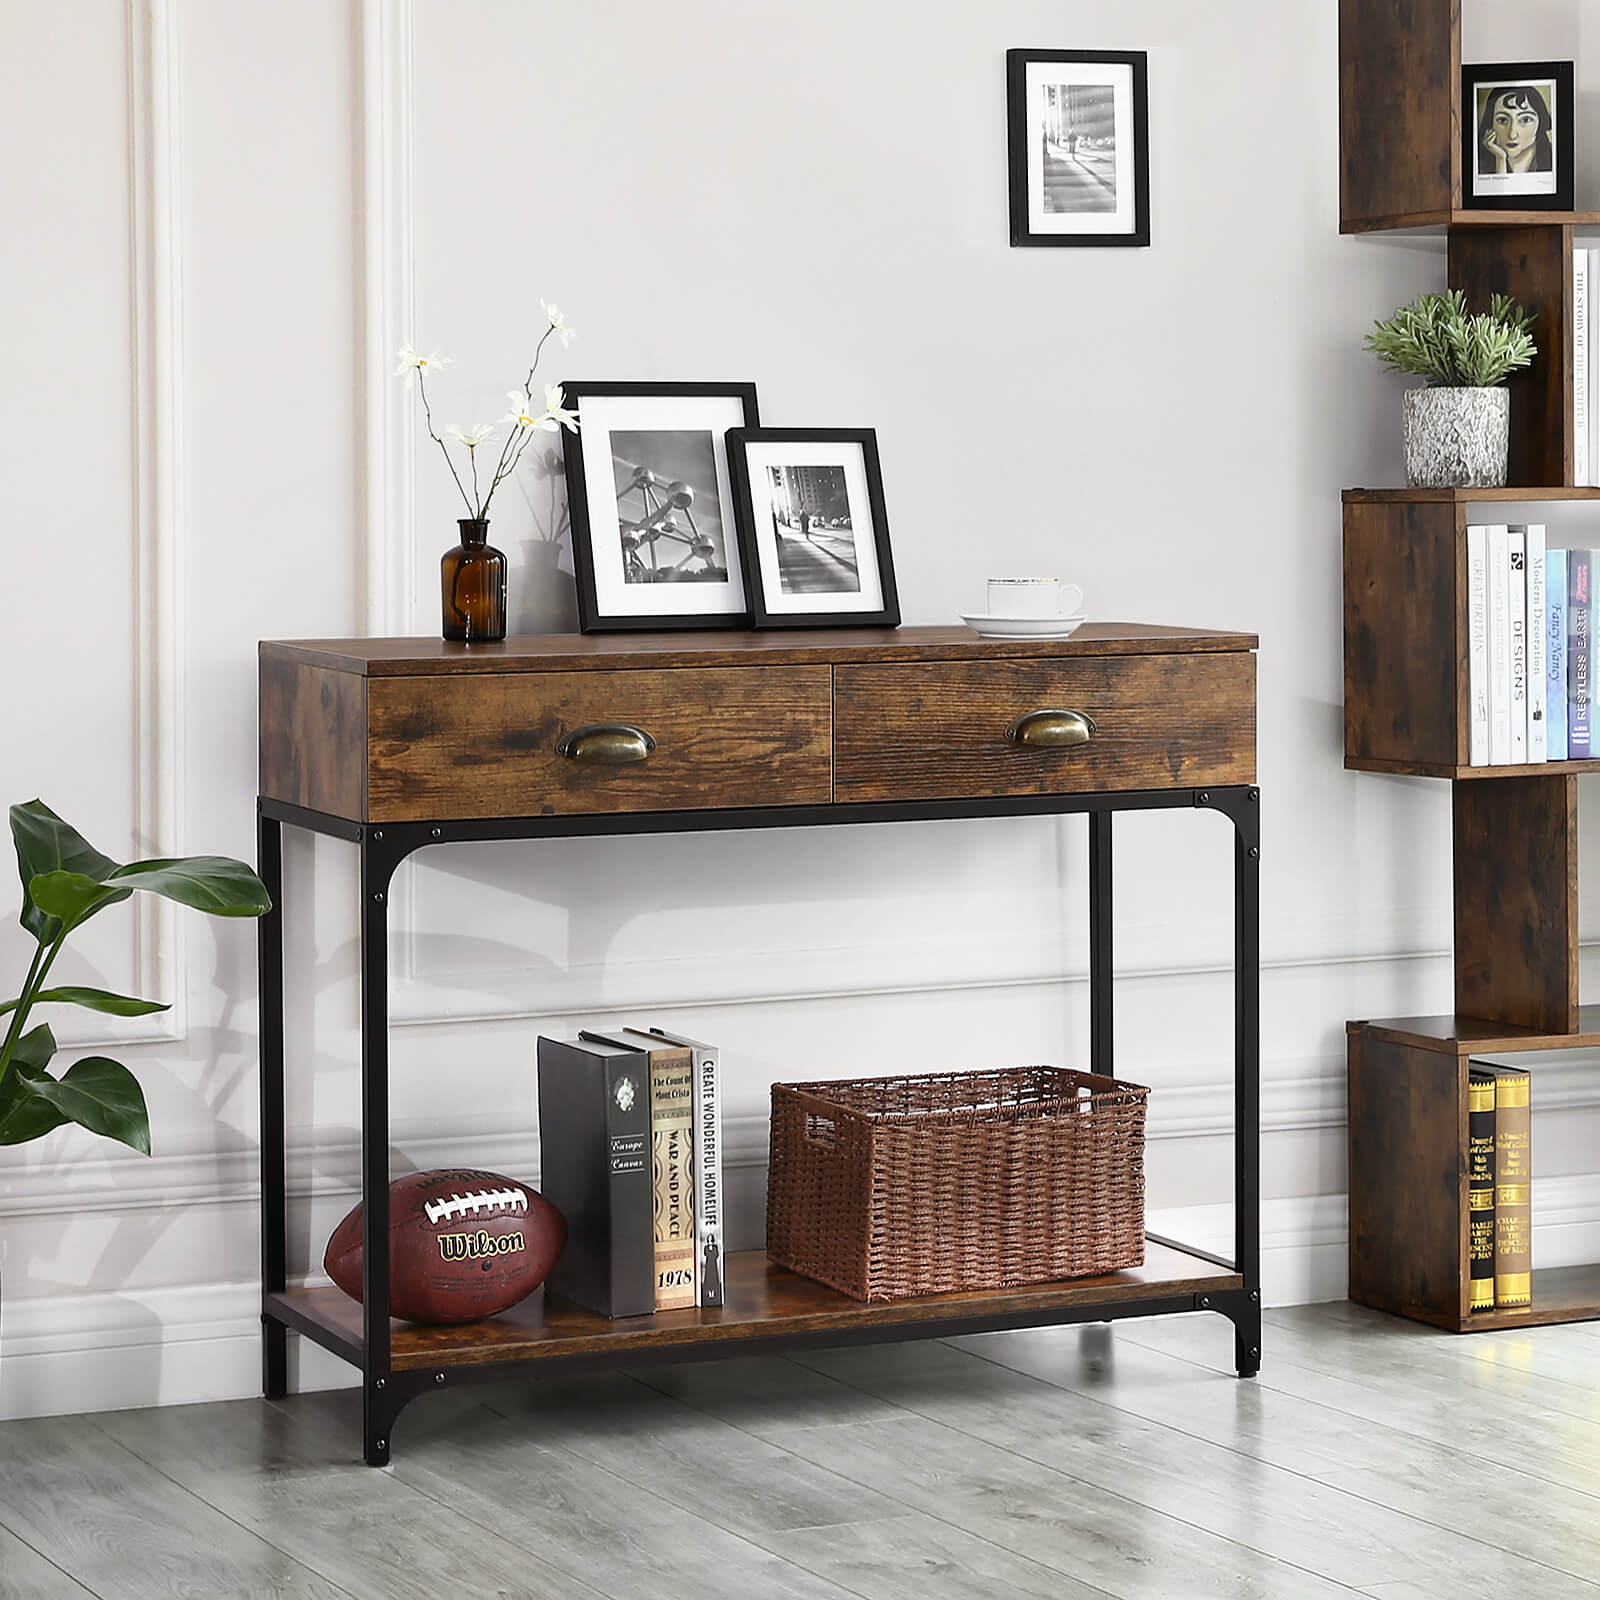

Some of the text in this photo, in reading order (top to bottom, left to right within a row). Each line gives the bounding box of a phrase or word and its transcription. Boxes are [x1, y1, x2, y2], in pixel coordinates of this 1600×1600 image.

[1576, 272, 1584, 295] THE
[1576, 296, 1584, 332] STORY
[1576, 334, 1584, 350] OF
[1576, 353, 1584, 374] THE
[1473, 559, 1484, 654] GREAT BRITAIN
[1533, 558, 1542, 674] Modern Decoration
[1548, 602, 1562, 681] Fancy Nancy
[1576, 608, 1587, 649] EARTH
[1513, 621, 1523, 701] DESIGNS
[1577, 653, 1587, 720] RESTLESS
[654, 1075, 691, 1087] The Count Of
[655, 1089, 690, 1100] Mont Cristo
[610, 1140, 643, 1152] Europe
[702, 1060, 717, 1226] CREATE WONDERFUL HOMELIFE
[610, 1159, 643, 1169] Canvas
[668, 1131, 680, 1239] WAR AND PEACE
[437, 1229, 526, 1261] Wilson
[658, 1270, 692, 1289] 1978
